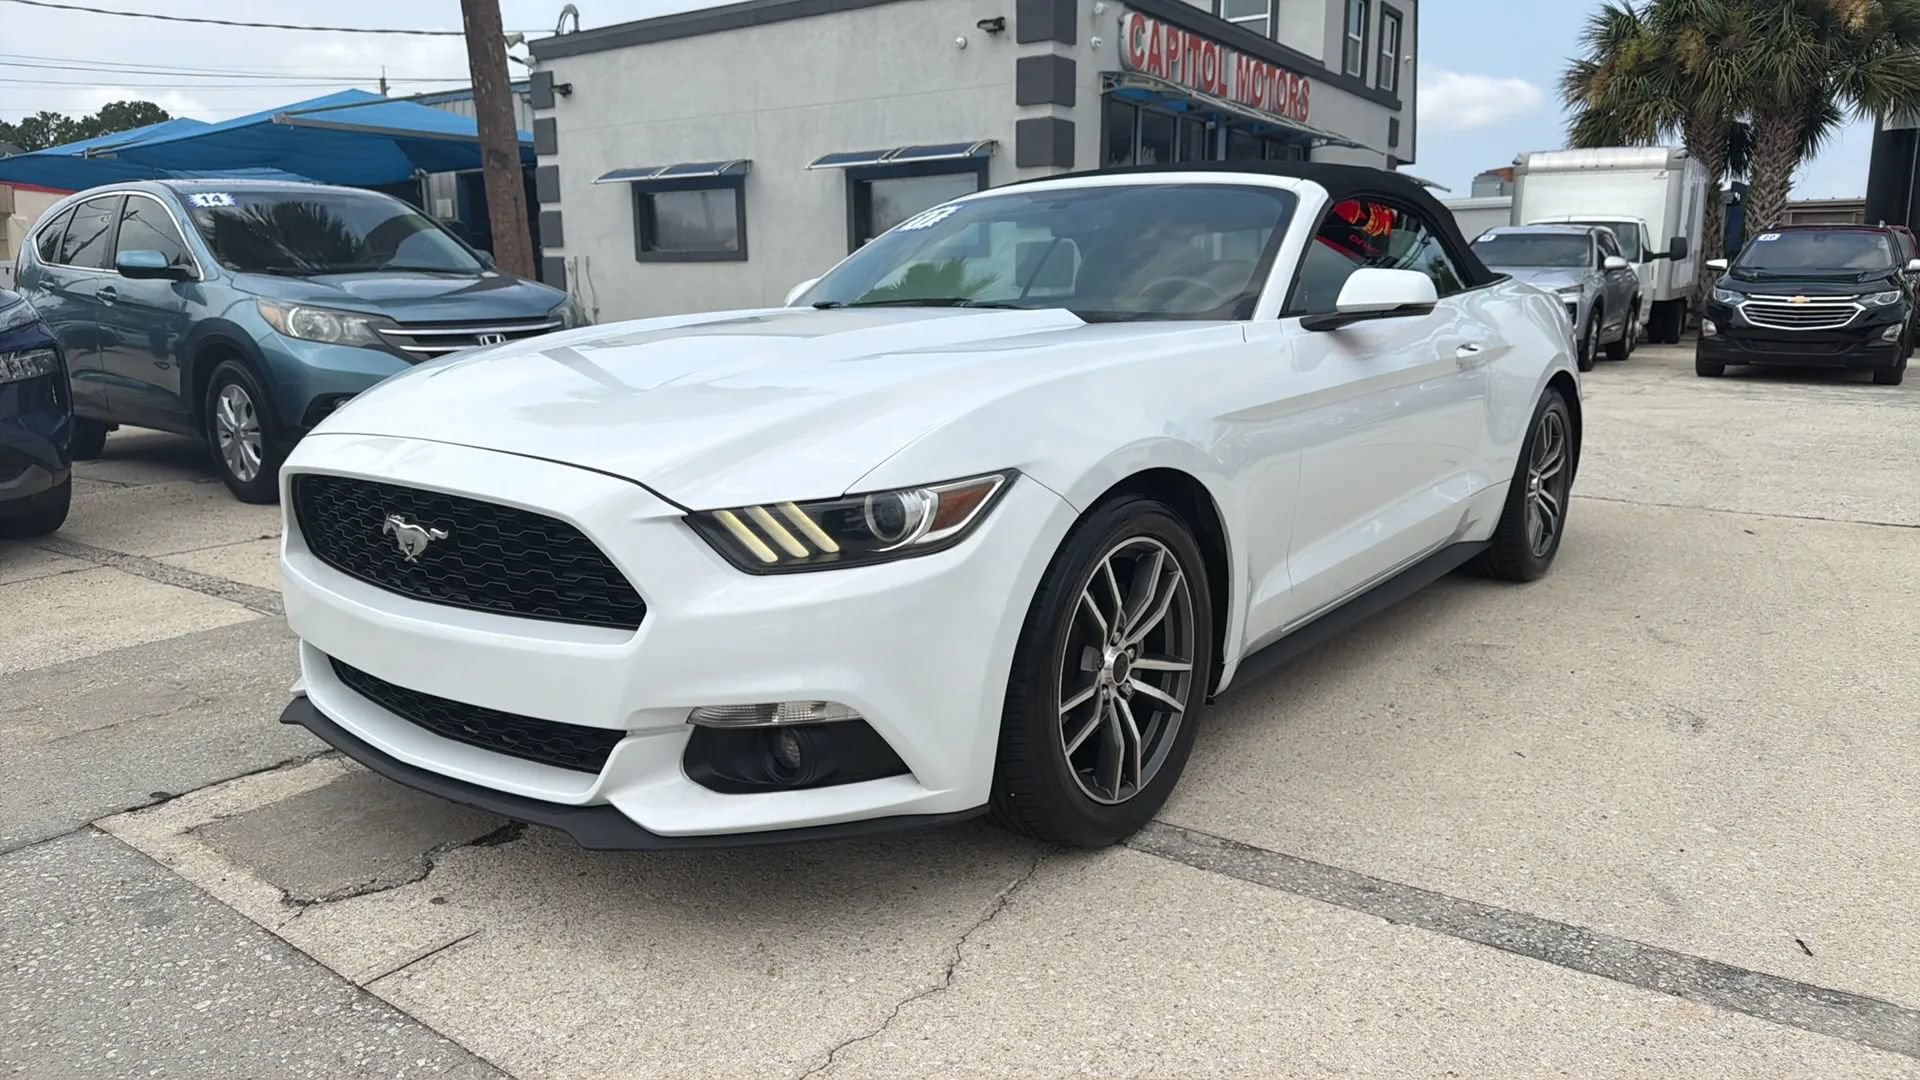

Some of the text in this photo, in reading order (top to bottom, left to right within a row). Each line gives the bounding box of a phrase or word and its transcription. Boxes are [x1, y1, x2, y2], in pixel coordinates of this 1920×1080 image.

[1128, 11, 1310, 123] CAPITOL MOTORS
[200, 195, 223, 204] 14
